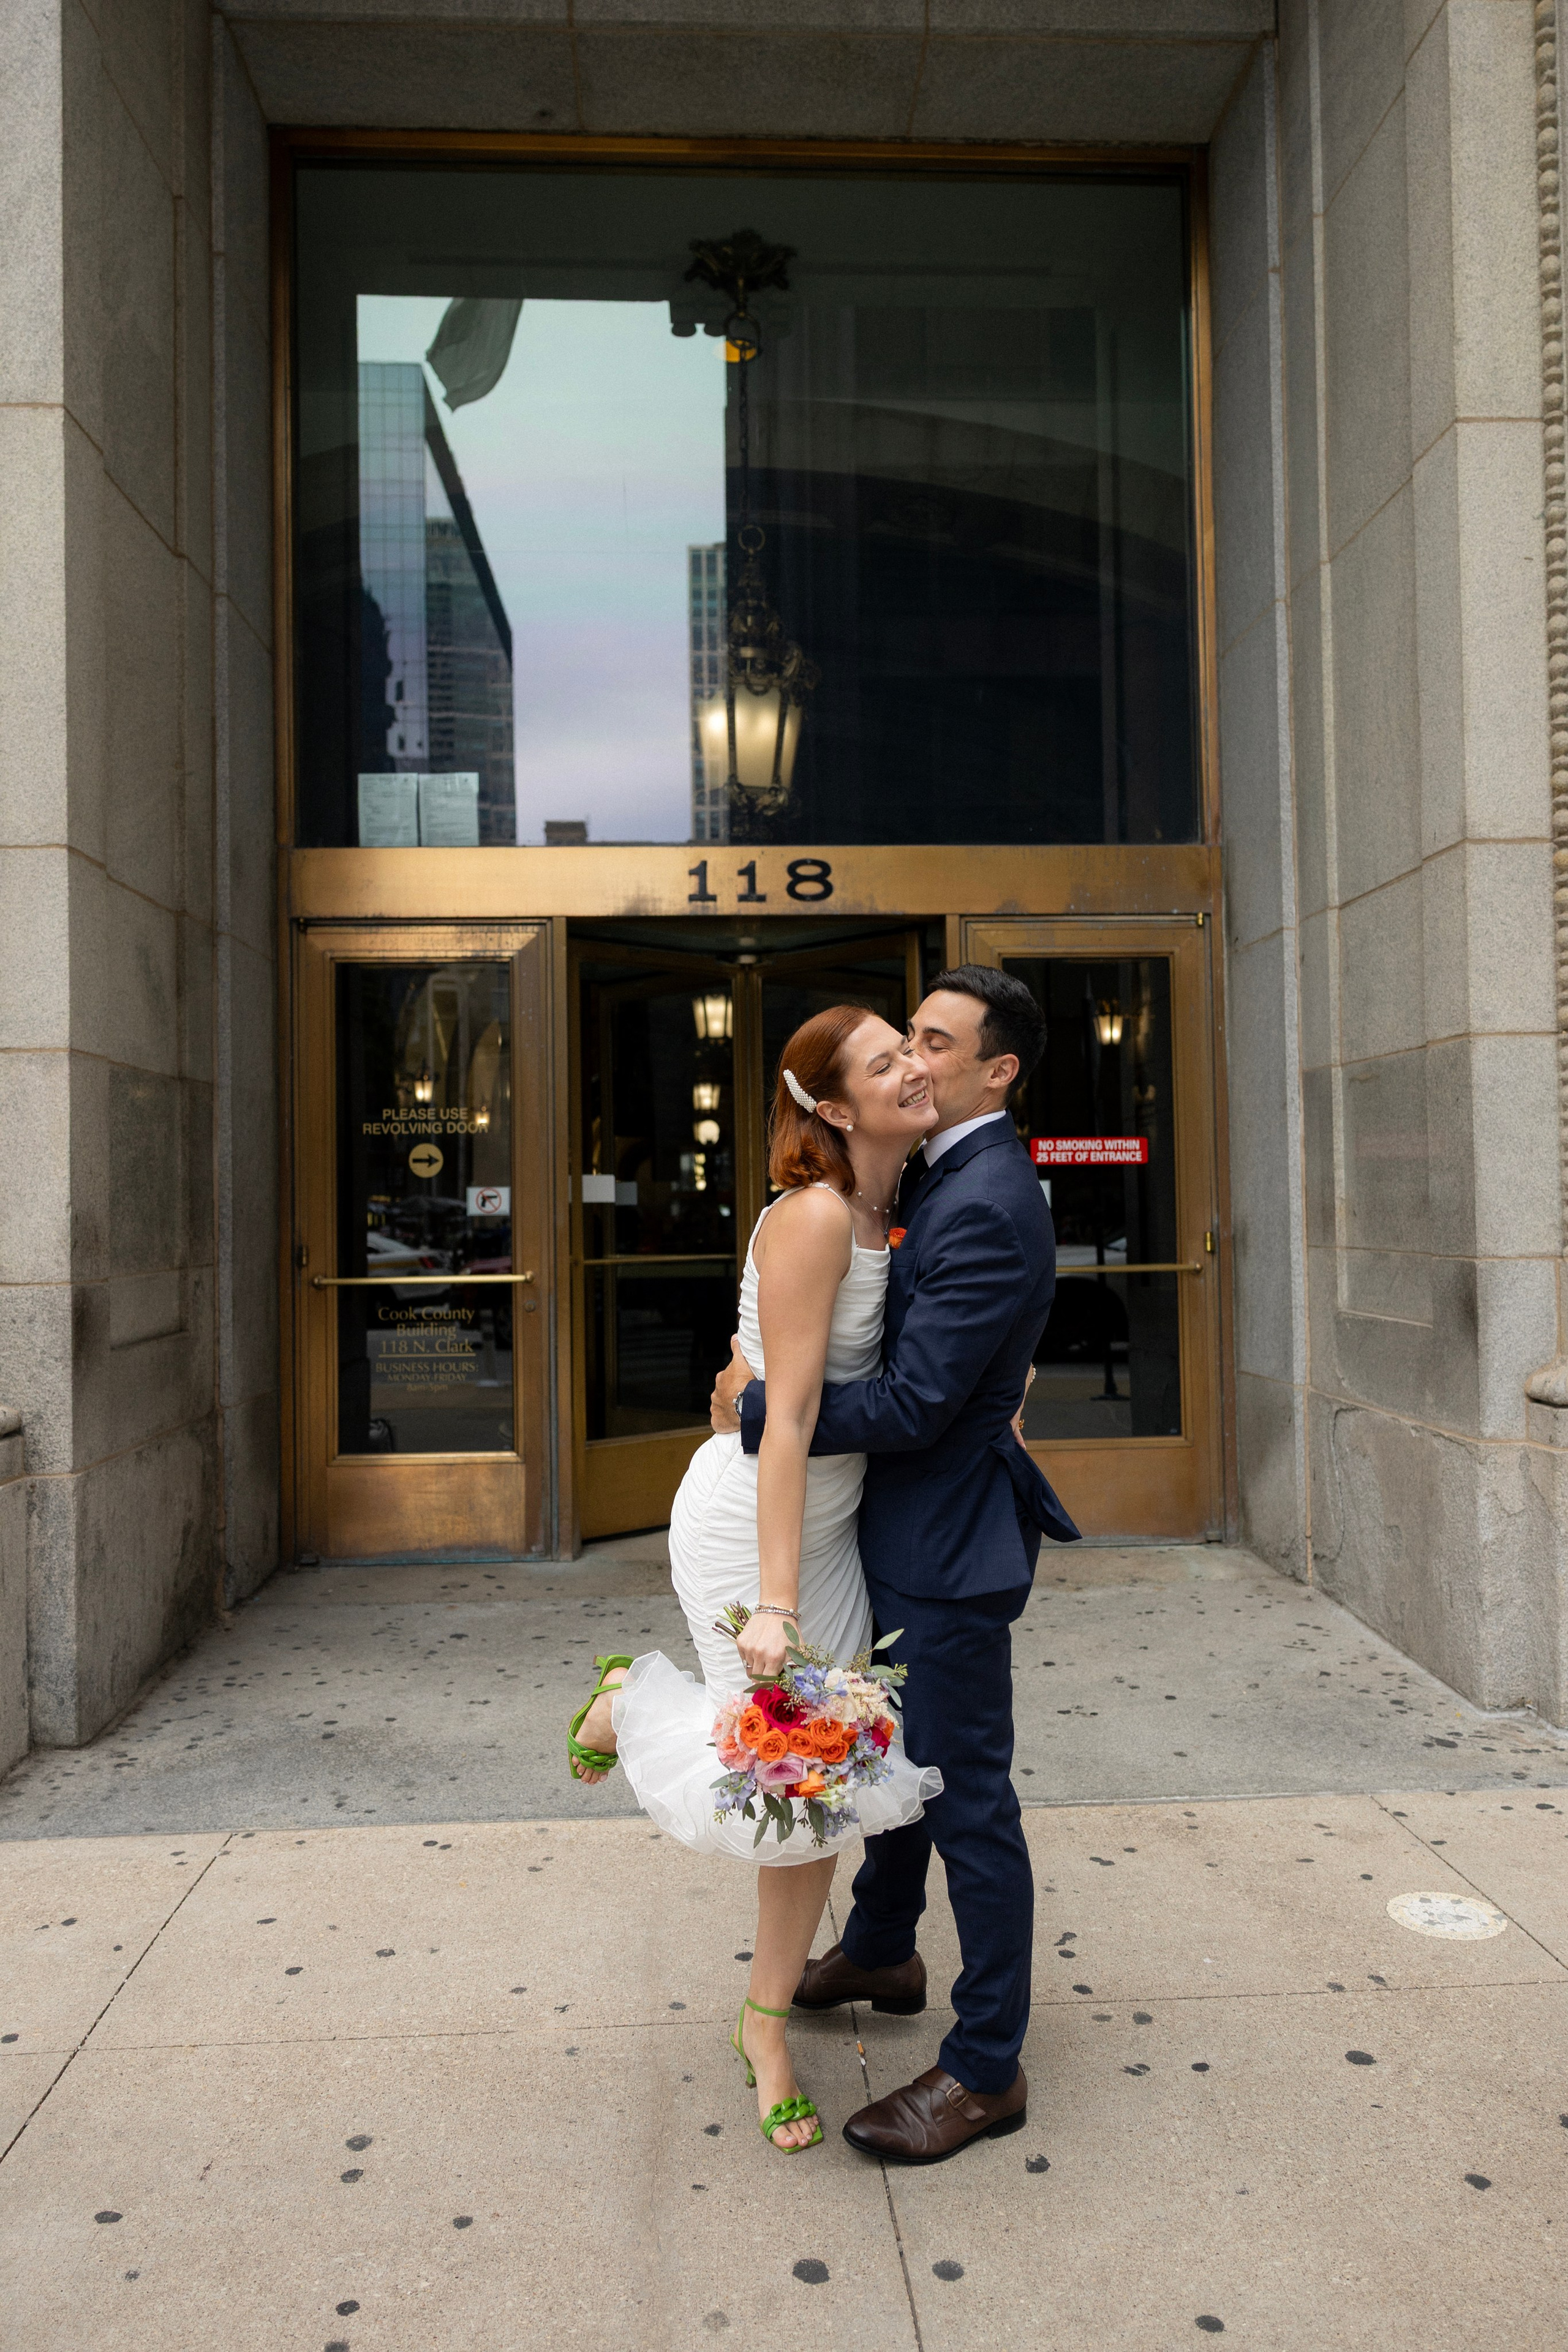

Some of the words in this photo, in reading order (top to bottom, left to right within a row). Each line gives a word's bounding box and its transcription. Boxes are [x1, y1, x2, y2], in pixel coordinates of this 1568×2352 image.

[688, 859, 833, 902] 118
[382, 1108, 435, 1120] PLEASE
[440, 1107, 468, 1120] USE
[363, 1122, 442, 1134] REVOLVING
[1038, 1140, 1054, 1151] NO
[1055, 1139, 1102, 1151] SMOKING
[1104, 1139, 1140, 1150] WITHIN
[1036, 1152, 1048, 1163] 25
[1050, 1152, 1072, 1162] FEET
[1074, 1152, 1088, 1162] OF
[1090, 1151, 1142, 1162] ENTRANCE
[378, 1306, 417, 1321] Cook
[421, 1306, 475, 1324] County
[397, 1322, 457, 1341] Building
[382, 1340, 407, 1354] 118
[413, 1340, 430, 1353] N.
[435, 1338, 473, 1353] Clark
[375, 1363, 429, 1373] BUSINESS
[433, 1362, 479, 1372] HOURS:
